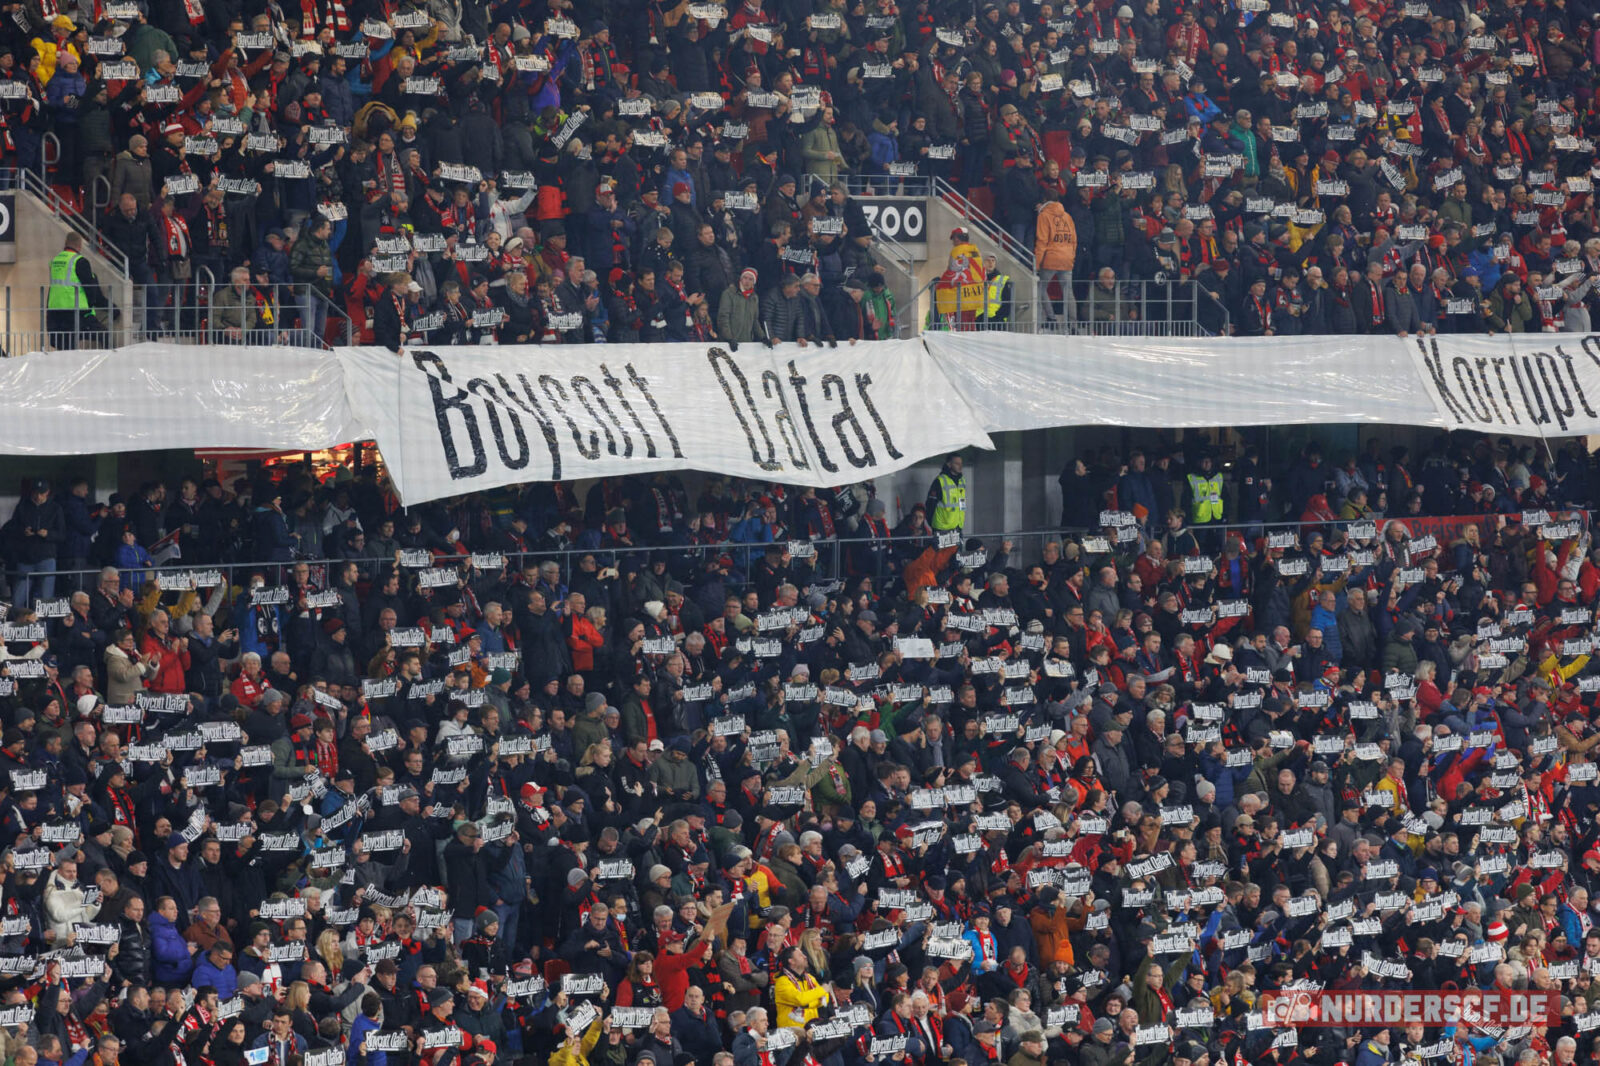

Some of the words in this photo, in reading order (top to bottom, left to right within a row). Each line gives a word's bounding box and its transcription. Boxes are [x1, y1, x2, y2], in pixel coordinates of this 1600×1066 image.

[411, 351, 687, 480] Boycott
[707, 347, 903, 473] Qatar
[419, 571, 442, 587] Boycott
[441, 568, 457, 584] Qatar
[3, 623, 29, 641] Boycott
[29, 623, 45, 639] Qatar
[7, 661, 29, 677] Boycott
[28, 660, 45, 676] Qatar
[137, 693, 166, 711] Boycott
[165, 695, 186, 710] Qatar
[104, 705, 125, 722] Boycott
[125, 705, 141, 720] Qatar
[198, 725, 224, 741] Boycott
[223, 723, 240, 739] Qatar
[128, 743, 150, 760] Boycott
[150, 743, 166, 759] Qatar
[14, 772, 32, 789] Boycott
[32, 770, 47, 786] Qatar
[320, 810, 344, 832] Boycott
[342, 800, 357, 819] Qatar
[42, 823, 64, 840] Boycott
[64, 823, 80, 839] Qatar
[217, 823, 236, 840] Boycott
[235, 823, 249, 837] Qatar
[261, 833, 285, 849] Boycott
[283, 833, 299, 848] Qatar
[363, 834, 387, 851] Boycott
[386, 833, 402, 848] Qatar
[13, 851, 35, 867] Boycott
[34, 849, 49, 865] Qatar
[1127, 859, 1152, 878] Boycott
[1150, 852, 1172, 870] Qatar
[599, 861, 619, 877] Boycott
[618, 860, 632, 875] Qatar
[260, 901, 287, 917] Boycott
[286, 900, 304, 915] Qatar
[76, 924, 100, 942] Boycott
[100, 924, 119, 941] Qatar
[269, 943, 289, 961] Boycott
[288, 941, 304, 957] Qatar
[61, 958, 86, 976] Boycott
[85, 957, 105, 973] Qatar
[507, 979, 528, 996] Boycott
[527, 976, 544, 992] Qatar
[563, 975, 589, 993] Boycott
[588, 975, 603, 991] Qatar
[611, 1009, 636, 1027] Boycott
[635, 1009, 653, 1025] Qatar
[366, 1032, 391, 1049] Boycott
[389, 1032, 407, 1048] Qatar
[424, 1030, 445, 1047] Boycott
[444, 1028, 460, 1044] Qatar
